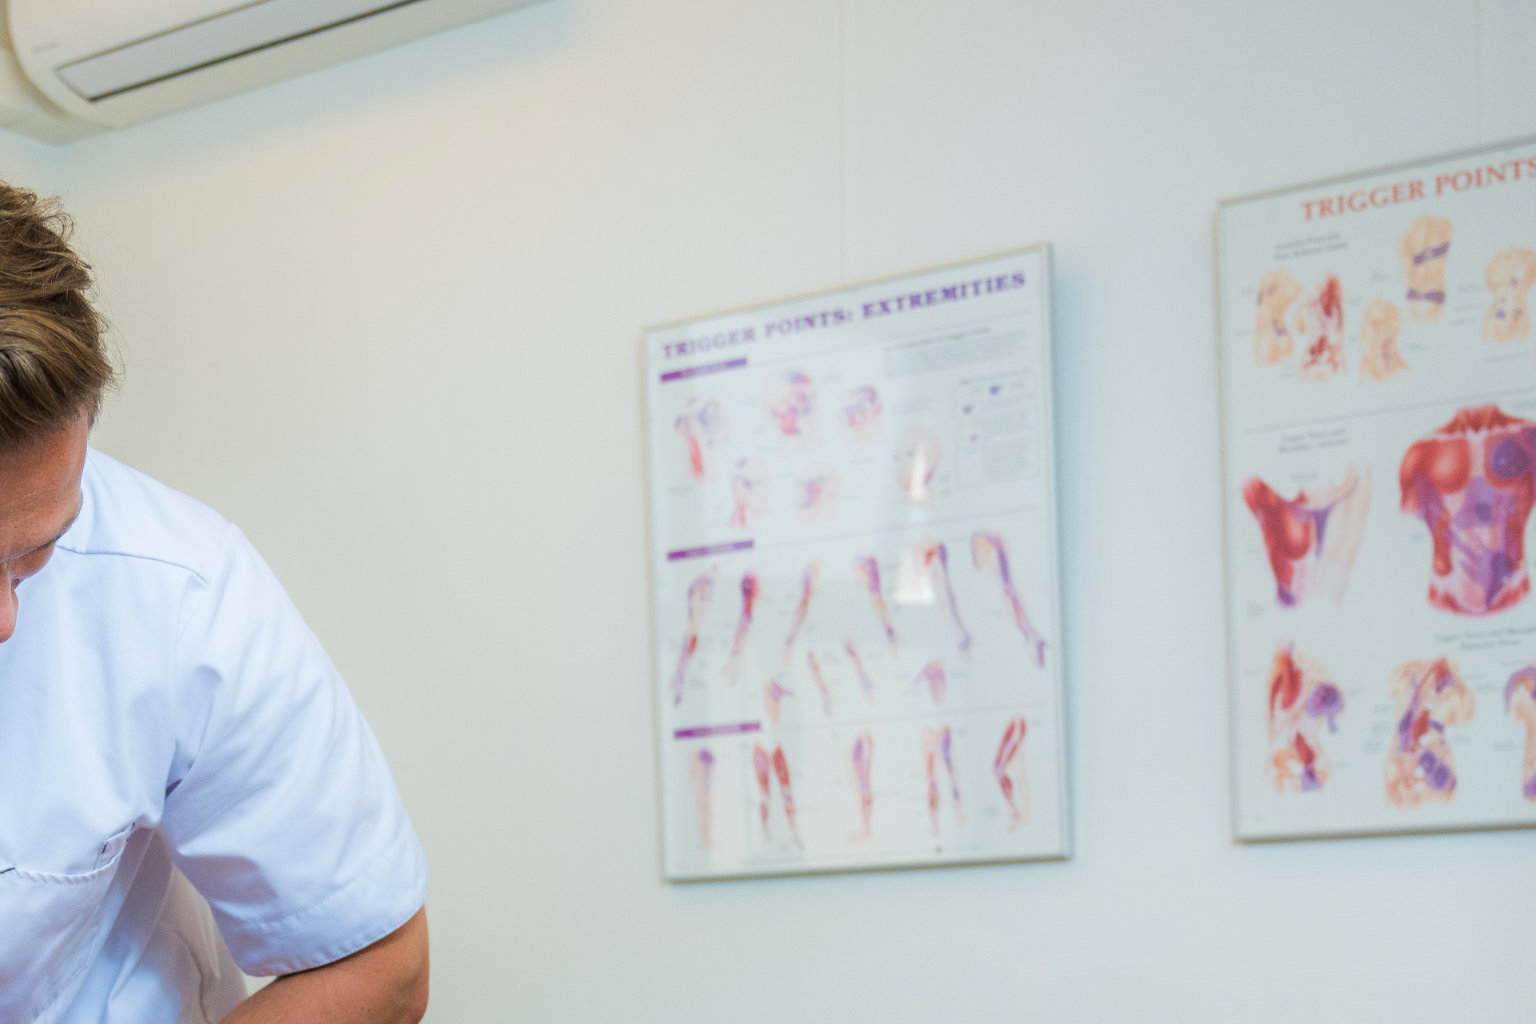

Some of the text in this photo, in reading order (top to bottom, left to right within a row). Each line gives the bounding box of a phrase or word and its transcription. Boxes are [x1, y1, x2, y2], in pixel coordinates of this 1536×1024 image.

[1302, 180, 1425, 221] TRIGGER
[662, 272, 1027, 359] TRIGGER POINTS: EXTREMITIES
